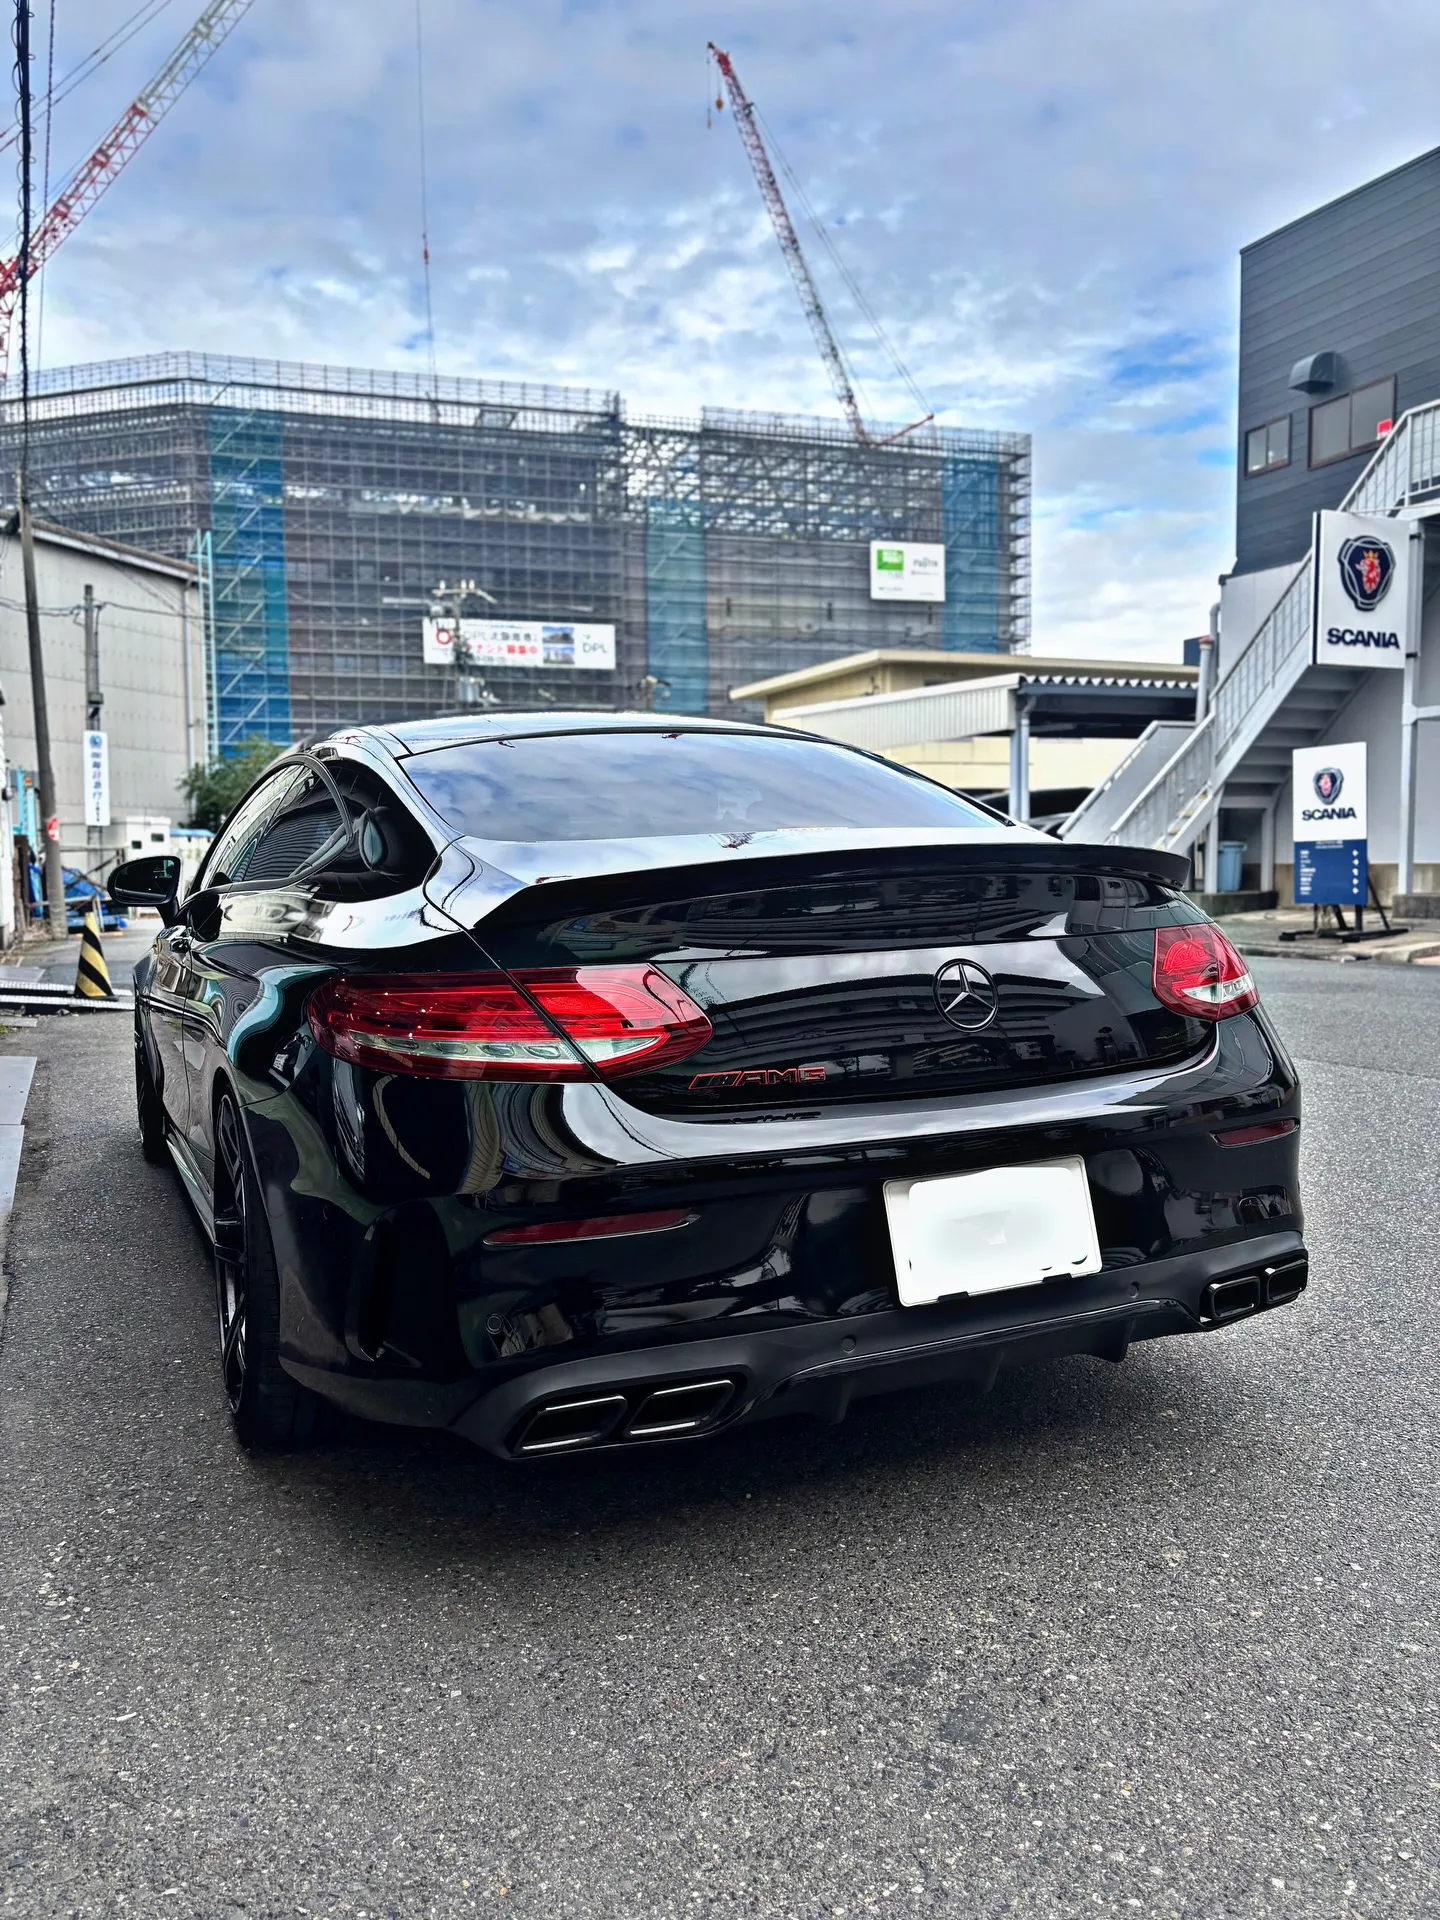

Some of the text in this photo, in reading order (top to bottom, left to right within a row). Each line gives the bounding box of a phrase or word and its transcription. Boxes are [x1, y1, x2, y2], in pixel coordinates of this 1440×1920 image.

[1327, 627, 1400, 650] SCANIA
[1302, 807, 1357, 822] SCANIA
[734, 1066, 826, 1087] AMG
